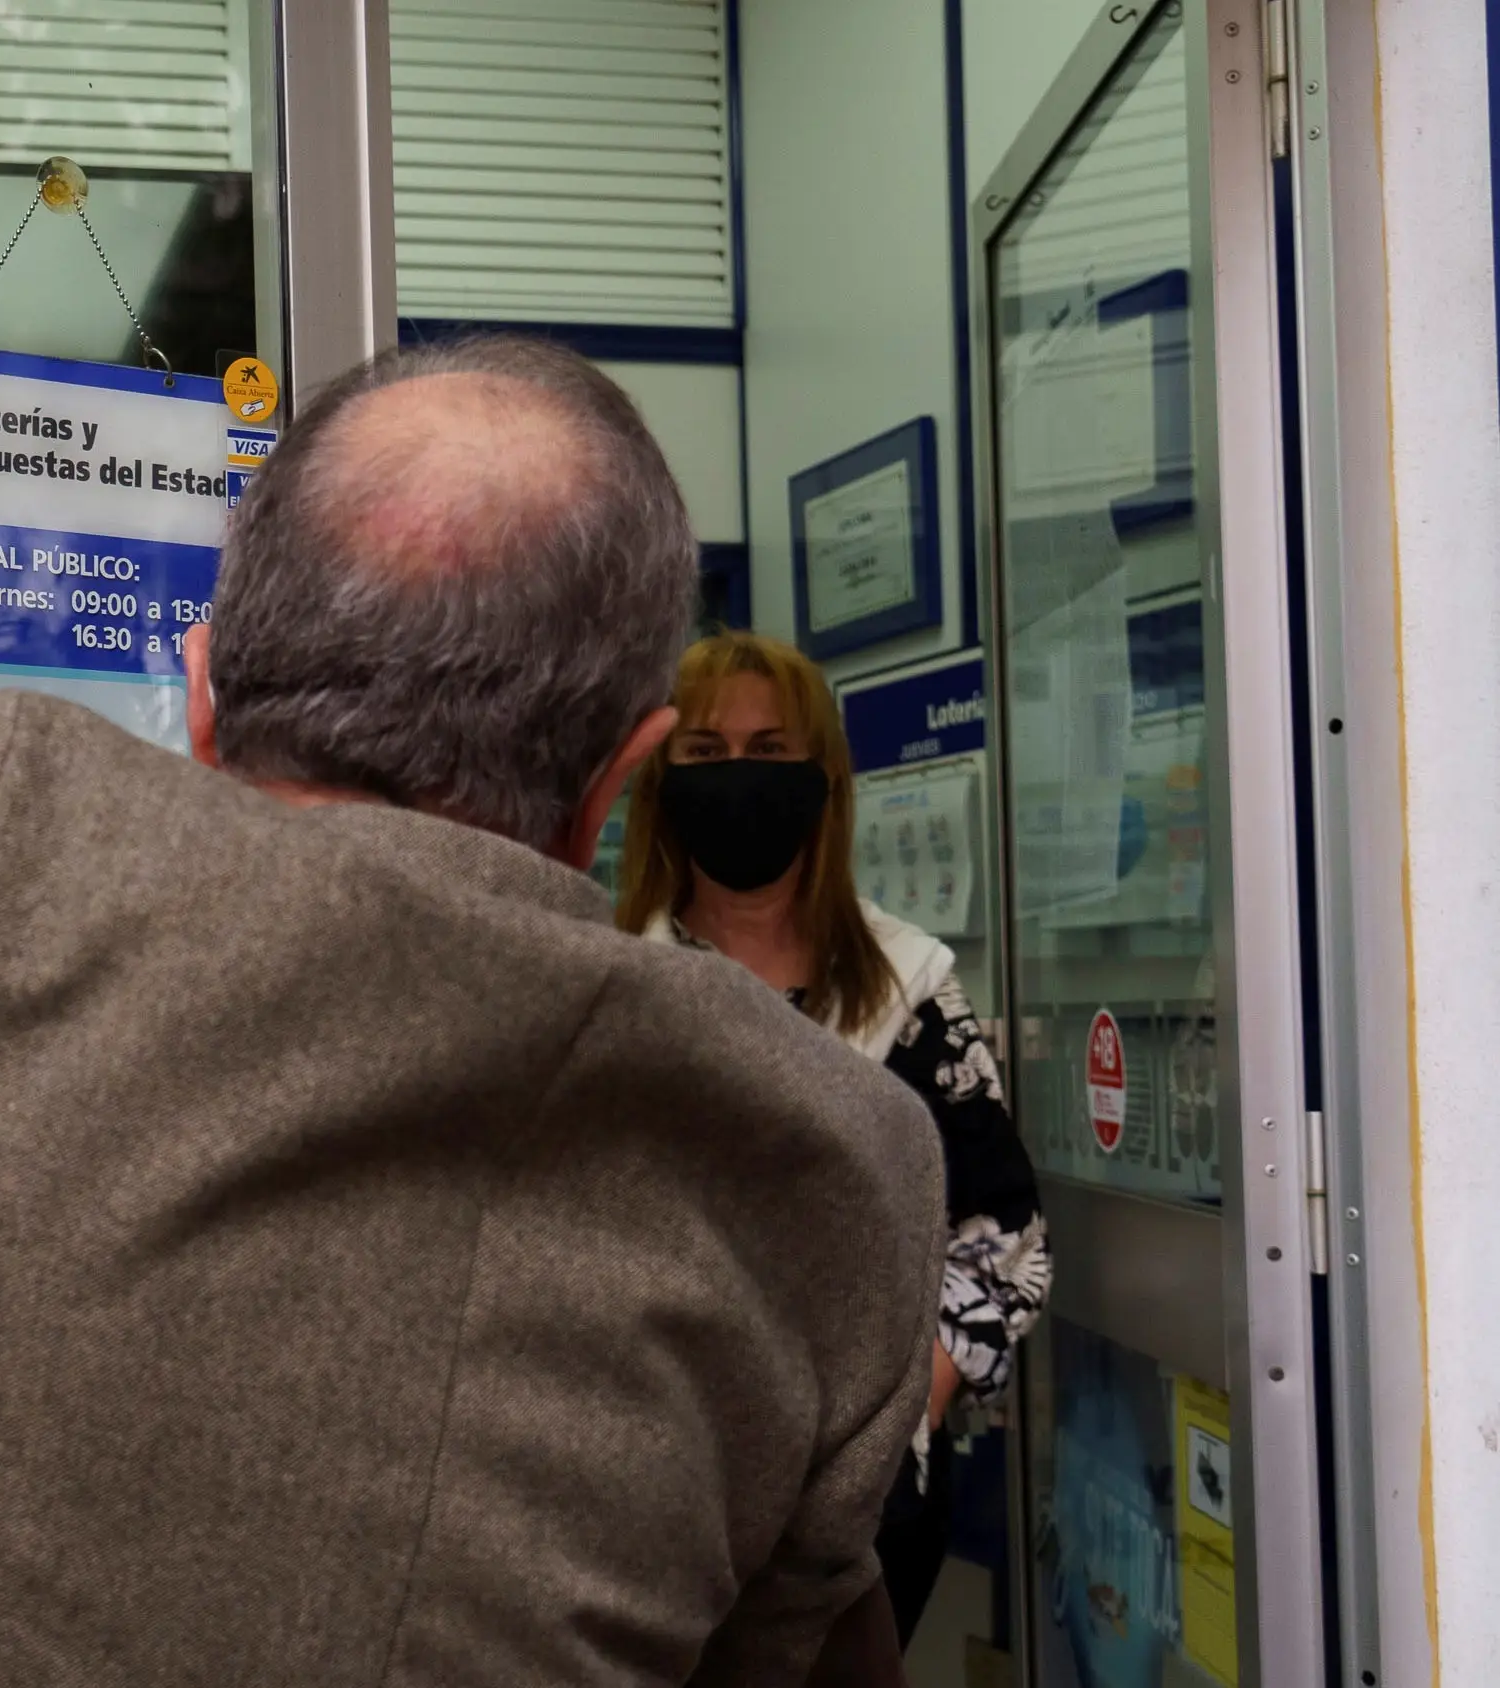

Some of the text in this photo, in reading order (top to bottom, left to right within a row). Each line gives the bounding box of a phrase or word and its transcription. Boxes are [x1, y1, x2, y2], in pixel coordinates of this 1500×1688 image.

[226, 384, 275, 399] Caixa Abierta
[82, 420, 99, 450] y
[234, 440, 269, 456] VISA
[99, 456, 142, 488] del
[151, 464, 227, 499] Estad
[32, 545, 140, 582] PÚBLICO:
[71, 589, 137, 618] 09:00
[147, 601, 161, 619] a
[171, 599, 213, 624] 13:0
[72, 624, 133, 650] 16.30
[147, 635, 161, 653] a
